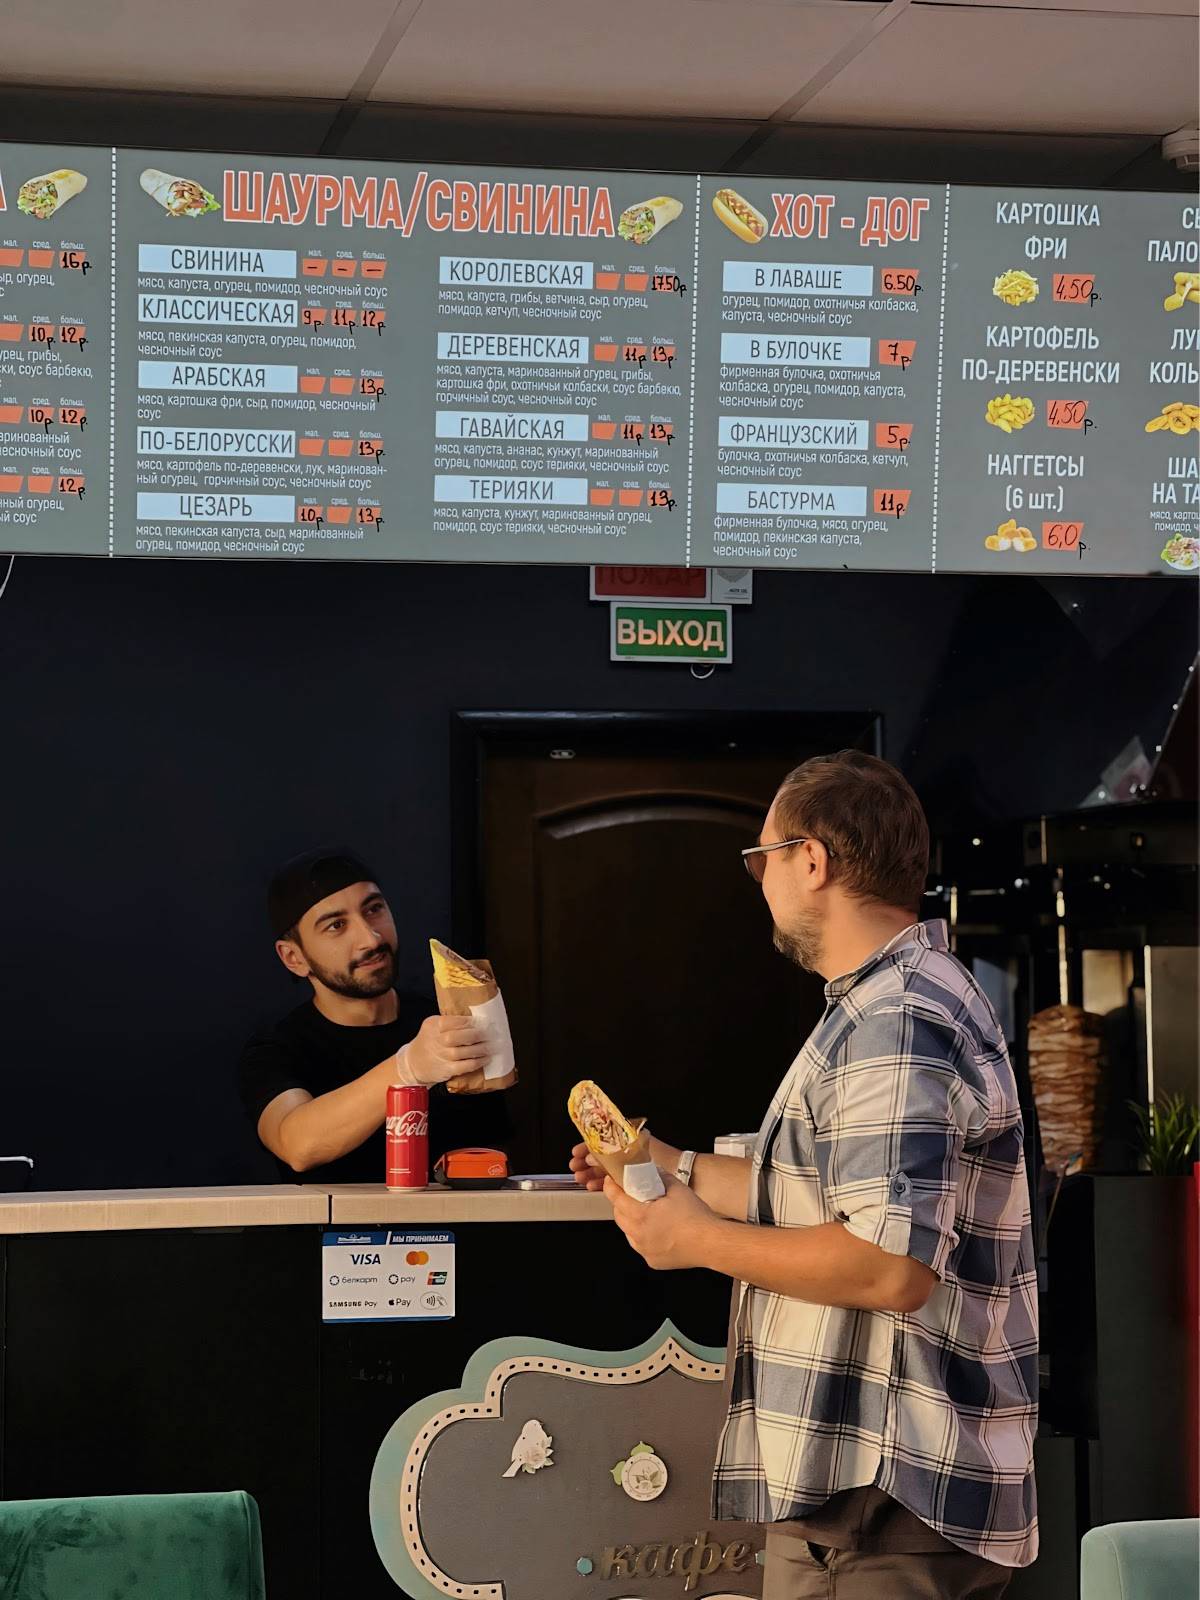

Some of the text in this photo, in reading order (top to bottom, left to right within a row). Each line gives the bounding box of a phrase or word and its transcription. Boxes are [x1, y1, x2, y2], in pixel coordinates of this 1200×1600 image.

[222, 169, 615, 239] ШАУРМА/СВИНИНА
[995, 201, 1100, 226] КАРТОШКА
[770, 193, 836, 238] ХОТ
[860, 197, 930, 247] ДОГ
[1025, 237, 1067, 260] ФРИ
[171, 248, 264, 272] СВИНИНА
[450, 260, 583, 286] КОРОЛЕВСКАЯ
[755, 269, 842, 289] В ЛАВАШЕ
[143, 298, 295, 324] КЛАССИЧЕСКАЯ
[722, 295, 919, 313] огурец, помидор, охотничья колбаска,
[722, 310, 852, 327] капуста, чесночный соус
[447, 335, 580, 358] ДЕРЕВЕНСКАЯ
[986, 326, 1100, 350] КАРТОФЕЛЬ
[1171, 329, 1200, 350] ЛУ
[750, 340, 842, 361] В БУЛОЧКЕ
[172, 365, 265, 388] АРАБСКАЯ
[720, 364, 881, 381] фирменная булочка, охотничья
[962, 359, 1120, 384] ПО-ДЕРЕВЕНСКИ
[720, 379, 906, 399] колбаска, огурец, помидор, капуста,
[719, 394, 804, 411] чесночный соус
[459, 415, 565, 439] ГАВАЙСКАЯ
[730, 422, 857, 446] ФРАНЦУЗСКИЙ
[140, 431, 293, 454] ПО-БЕЛОРУССКИ
[718, 448, 908, 468] булочка, охотничья колбаска, кетчуп,
[987, 454, 1084, 477] НАГГЕТСЫ
[717, 462, 802, 480] чесночный соус
[470, 479, 553, 500] ТЕРИЯКИ
[1005, 486, 1023, 512] (6
[1153, 483, 1176, 503] НА
[180, 496, 253, 519] ЦЕЗАРЬ
[748, 491, 835, 511] БАСТУРМА
[13, 513, 37, 525] соус
[714, 515, 888, 533] фирменная булочка, мясо, огурец,
[714, 531, 862, 547] помидор, пекинская капуста,
[713, 545, 797, 560] чесночный соус
[617, 618, 724, 652] ВЫХОД
[350, 1254, 380, 1264] VISA
[396, 1298, 411, 1306] Pay
[601, 1530, 752, 1591] кафе
